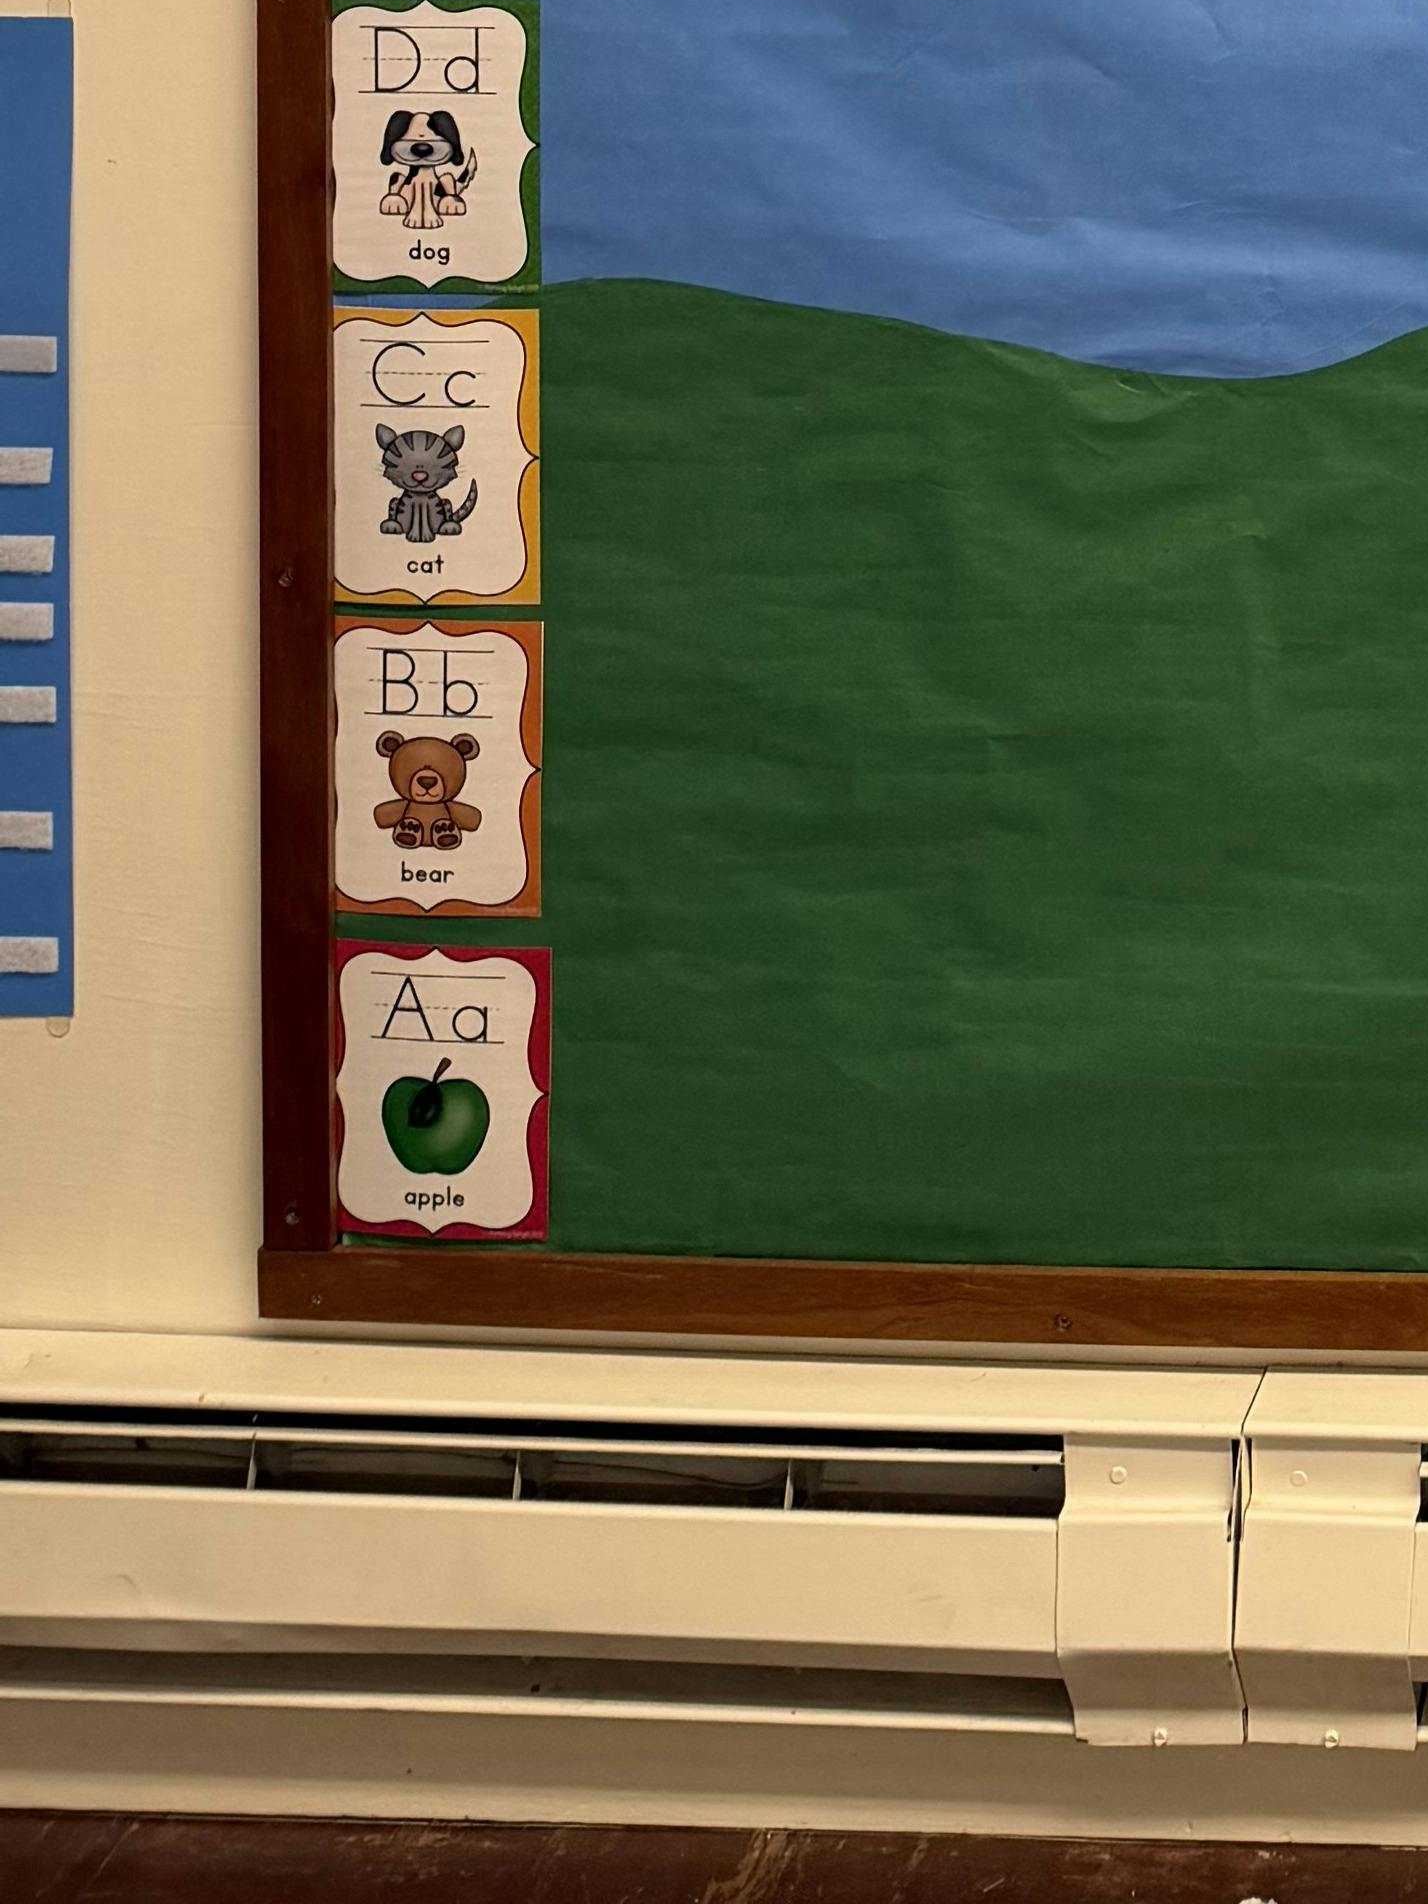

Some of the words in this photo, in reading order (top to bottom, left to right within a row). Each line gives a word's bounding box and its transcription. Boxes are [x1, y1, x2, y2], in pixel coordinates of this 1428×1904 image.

[374, 26, 479, 93] Dd
[407, 238, 451, 267] dog
[372, 342, 477, 407] Cc
[405, 553, 445, 575] cat
[383, 650, 479, 717] Bb
[400, 859, 456, 885] bear
[382, 975, 488, 1043] Aa
[403, 1184, 466, 1213] apple
